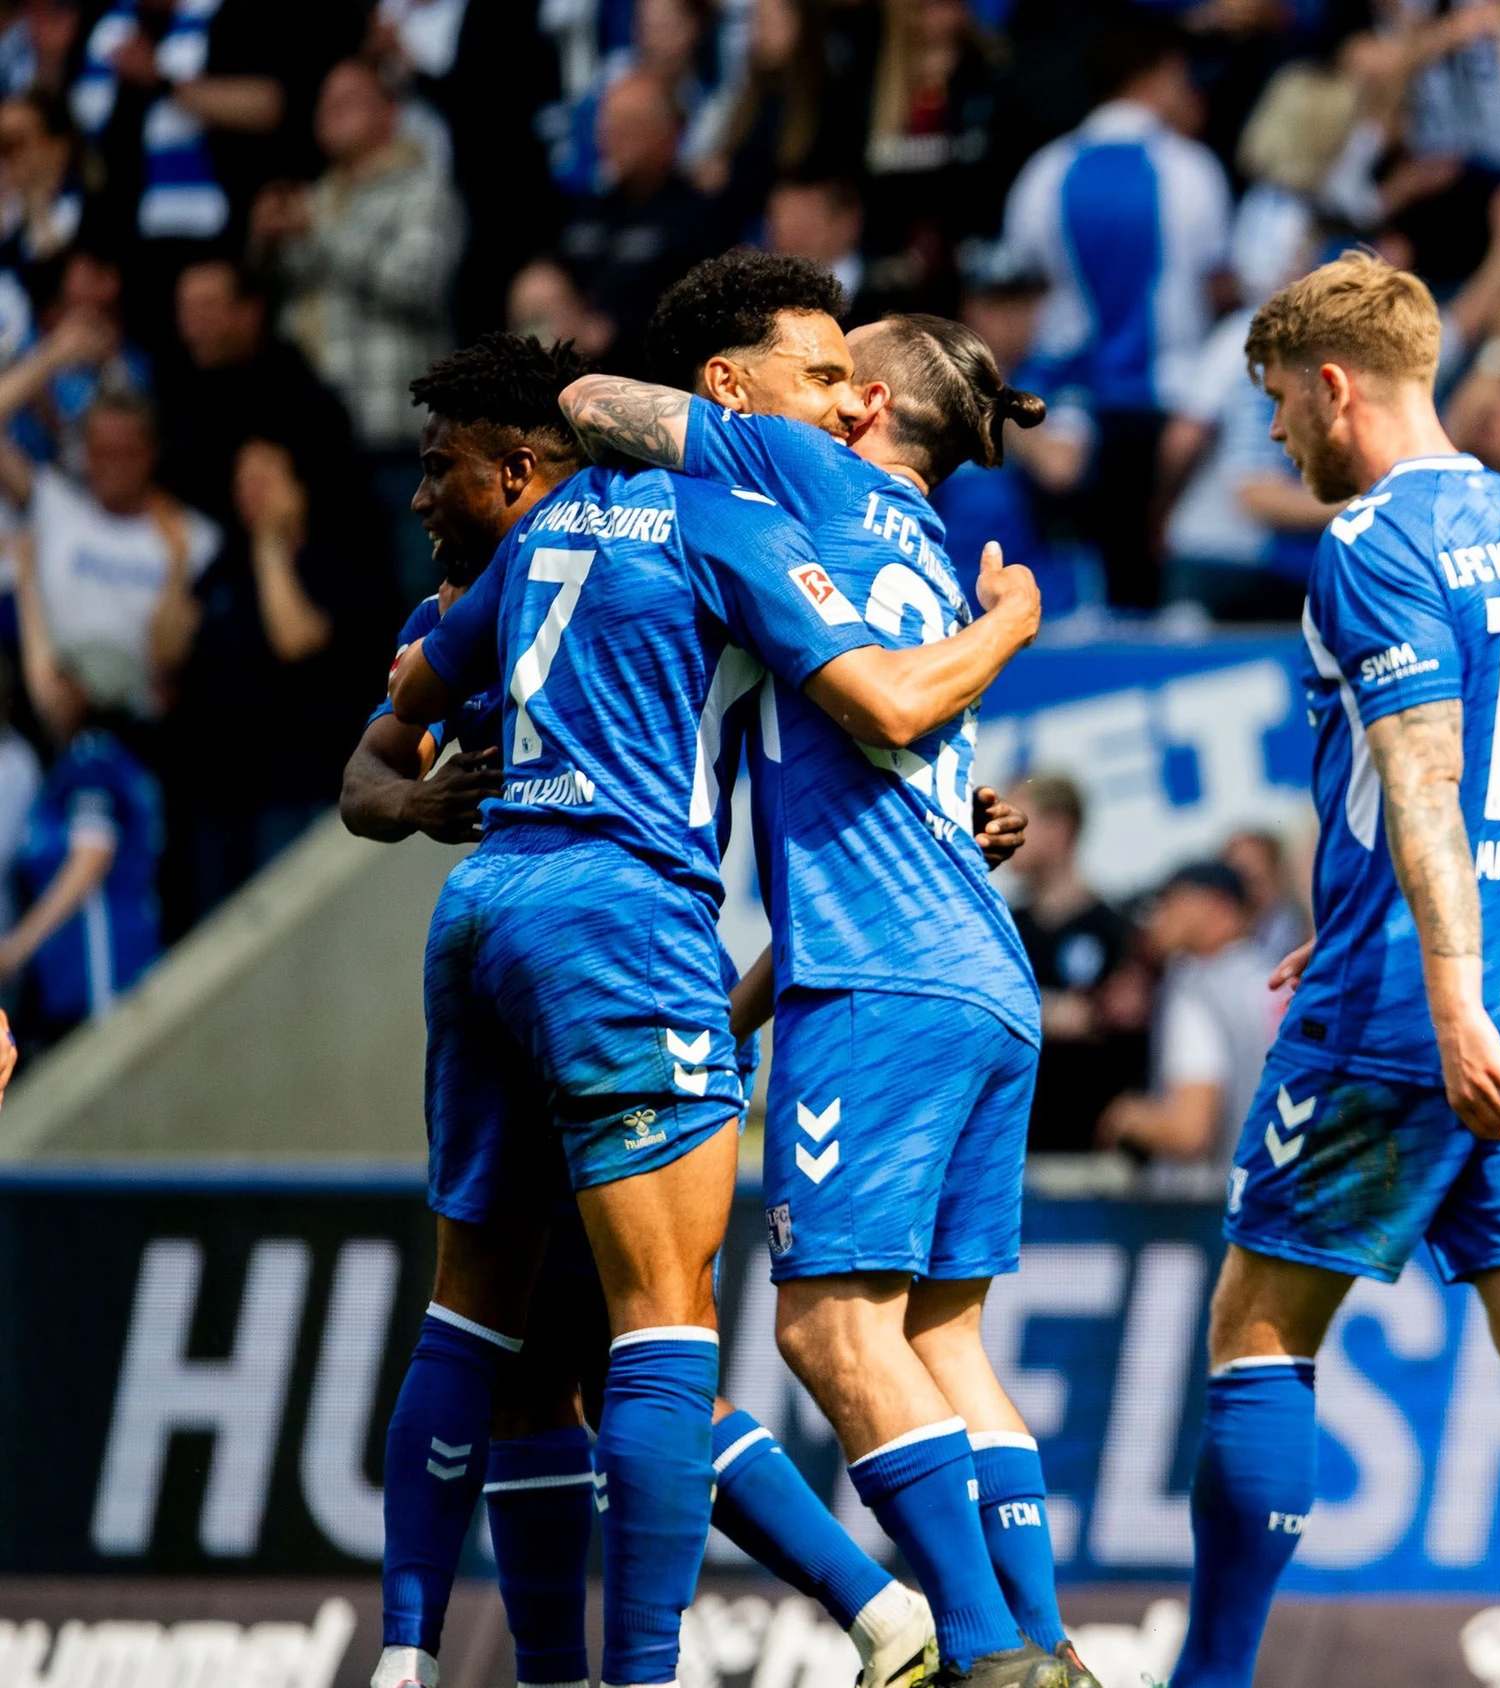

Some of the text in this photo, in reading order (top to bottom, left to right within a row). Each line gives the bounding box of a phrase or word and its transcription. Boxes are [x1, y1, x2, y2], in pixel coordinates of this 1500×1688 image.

[862, 491, 919, 555] 1.FC
[509, 547, 598, 767] 7
[1361, 642, 1418, 683] SWM
[624, 1130, 667, 1151] hummel
[998, 1502, 1041, 1529] FCM
